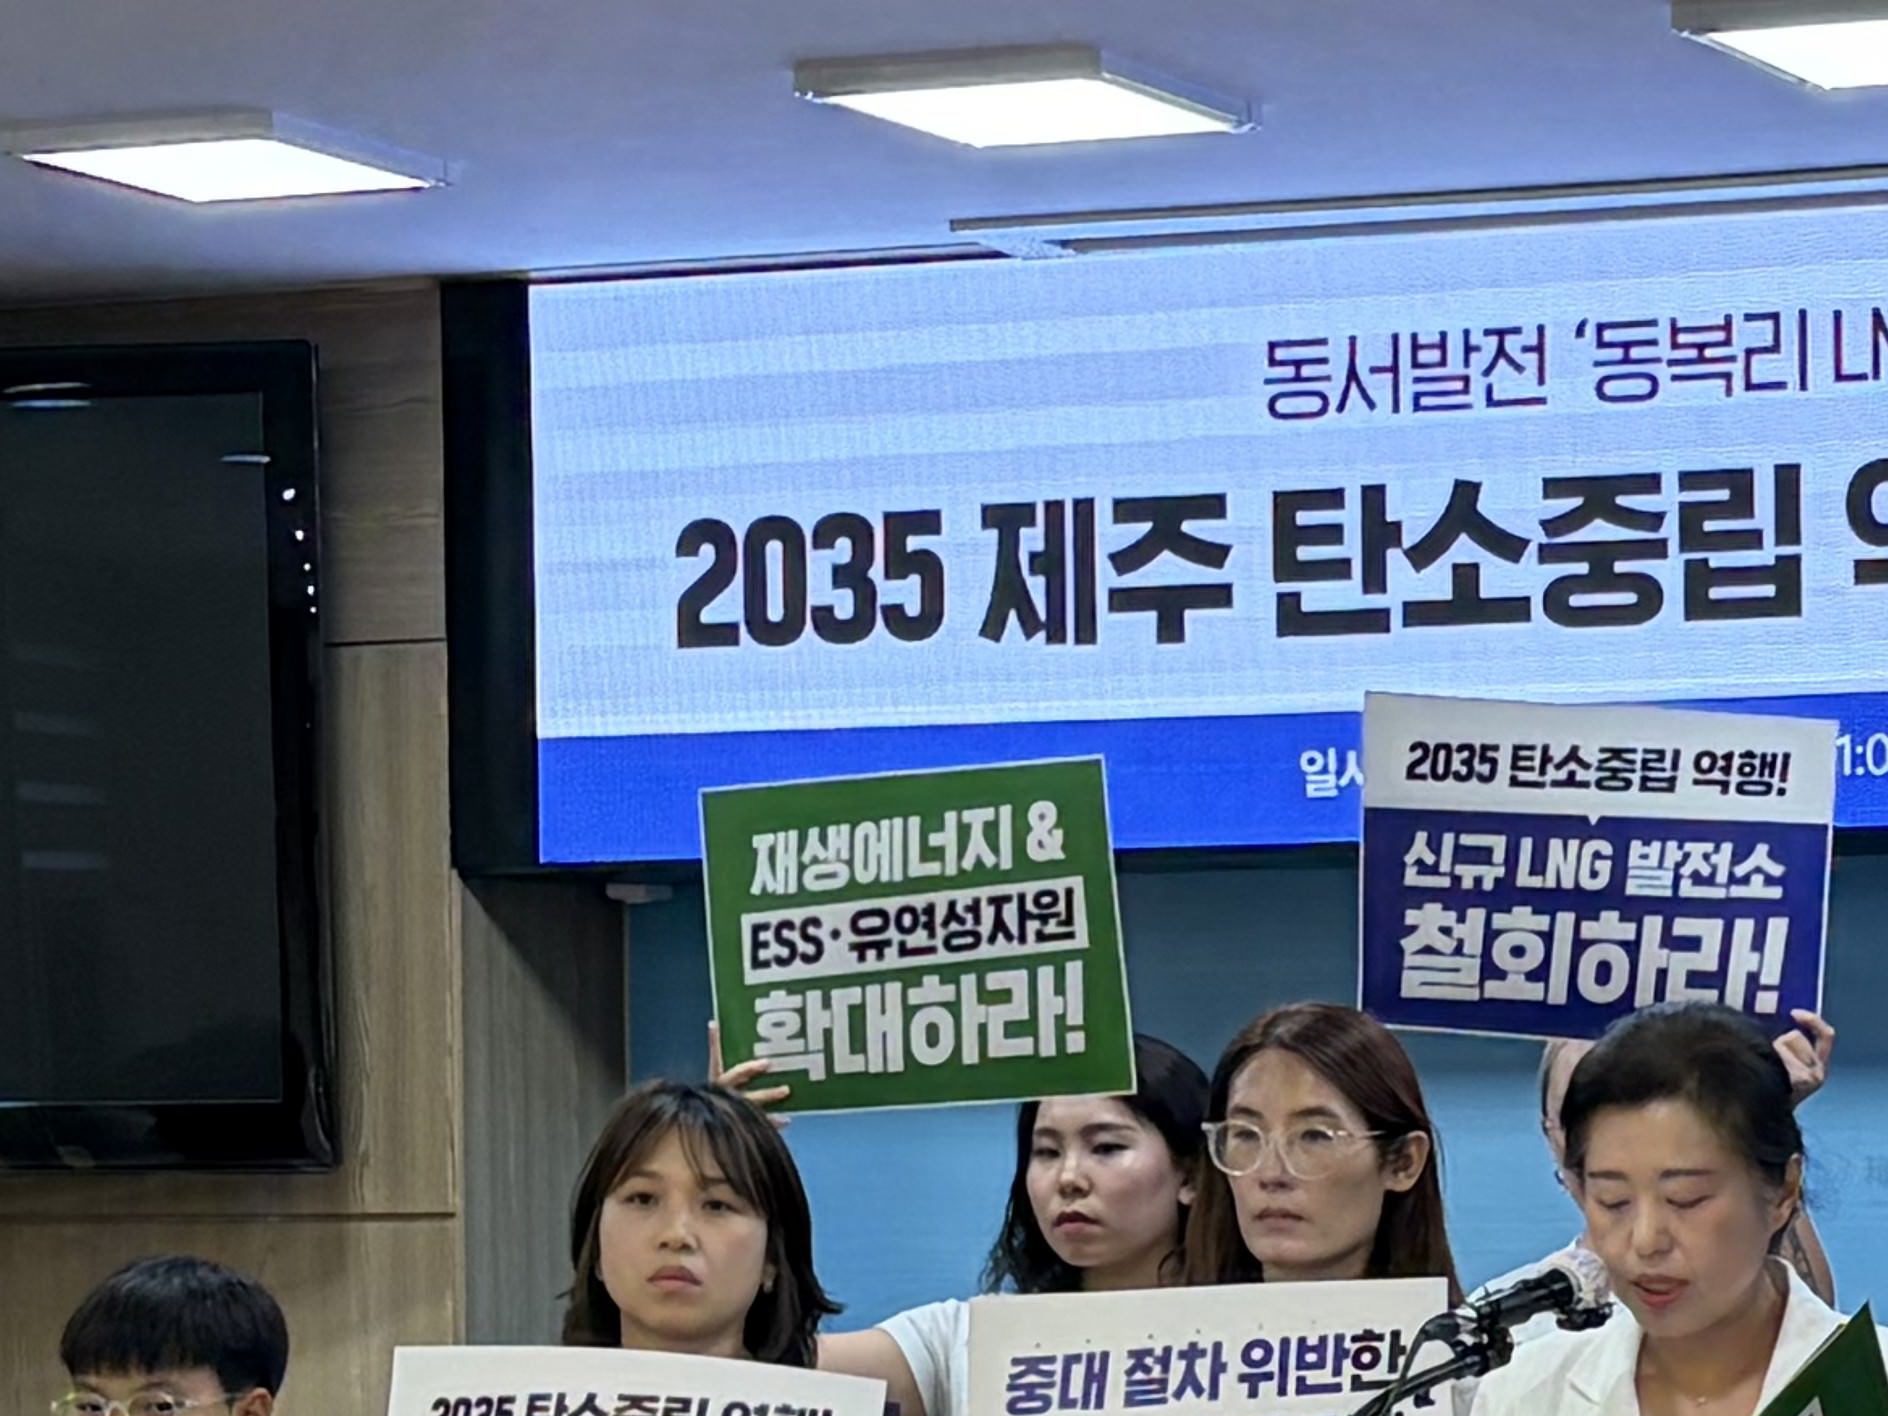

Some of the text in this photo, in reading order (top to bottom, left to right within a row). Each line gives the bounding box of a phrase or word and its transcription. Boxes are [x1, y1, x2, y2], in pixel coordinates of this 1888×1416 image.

[1264, 324, 1547, 420] 동서발전
[674, 509, 944, 649] 2035
[979, 493, 1233, 646] 제주
[1273, 463, 1802, 637] 탄소중립
[1405, 740, 1792, 797] 2035 탄소중립 역행!
[750, 800, 1065, 896] 재생에너지 &
[1403, 830, 1786, 900] 신규 LNG 발전소
[1400, 901, 1789, 1014] 철회하라!
[754, 960, 1085, 1082] 확대하라!
[1005, 1329, 1408, 1415] 중대 절차 위반한
